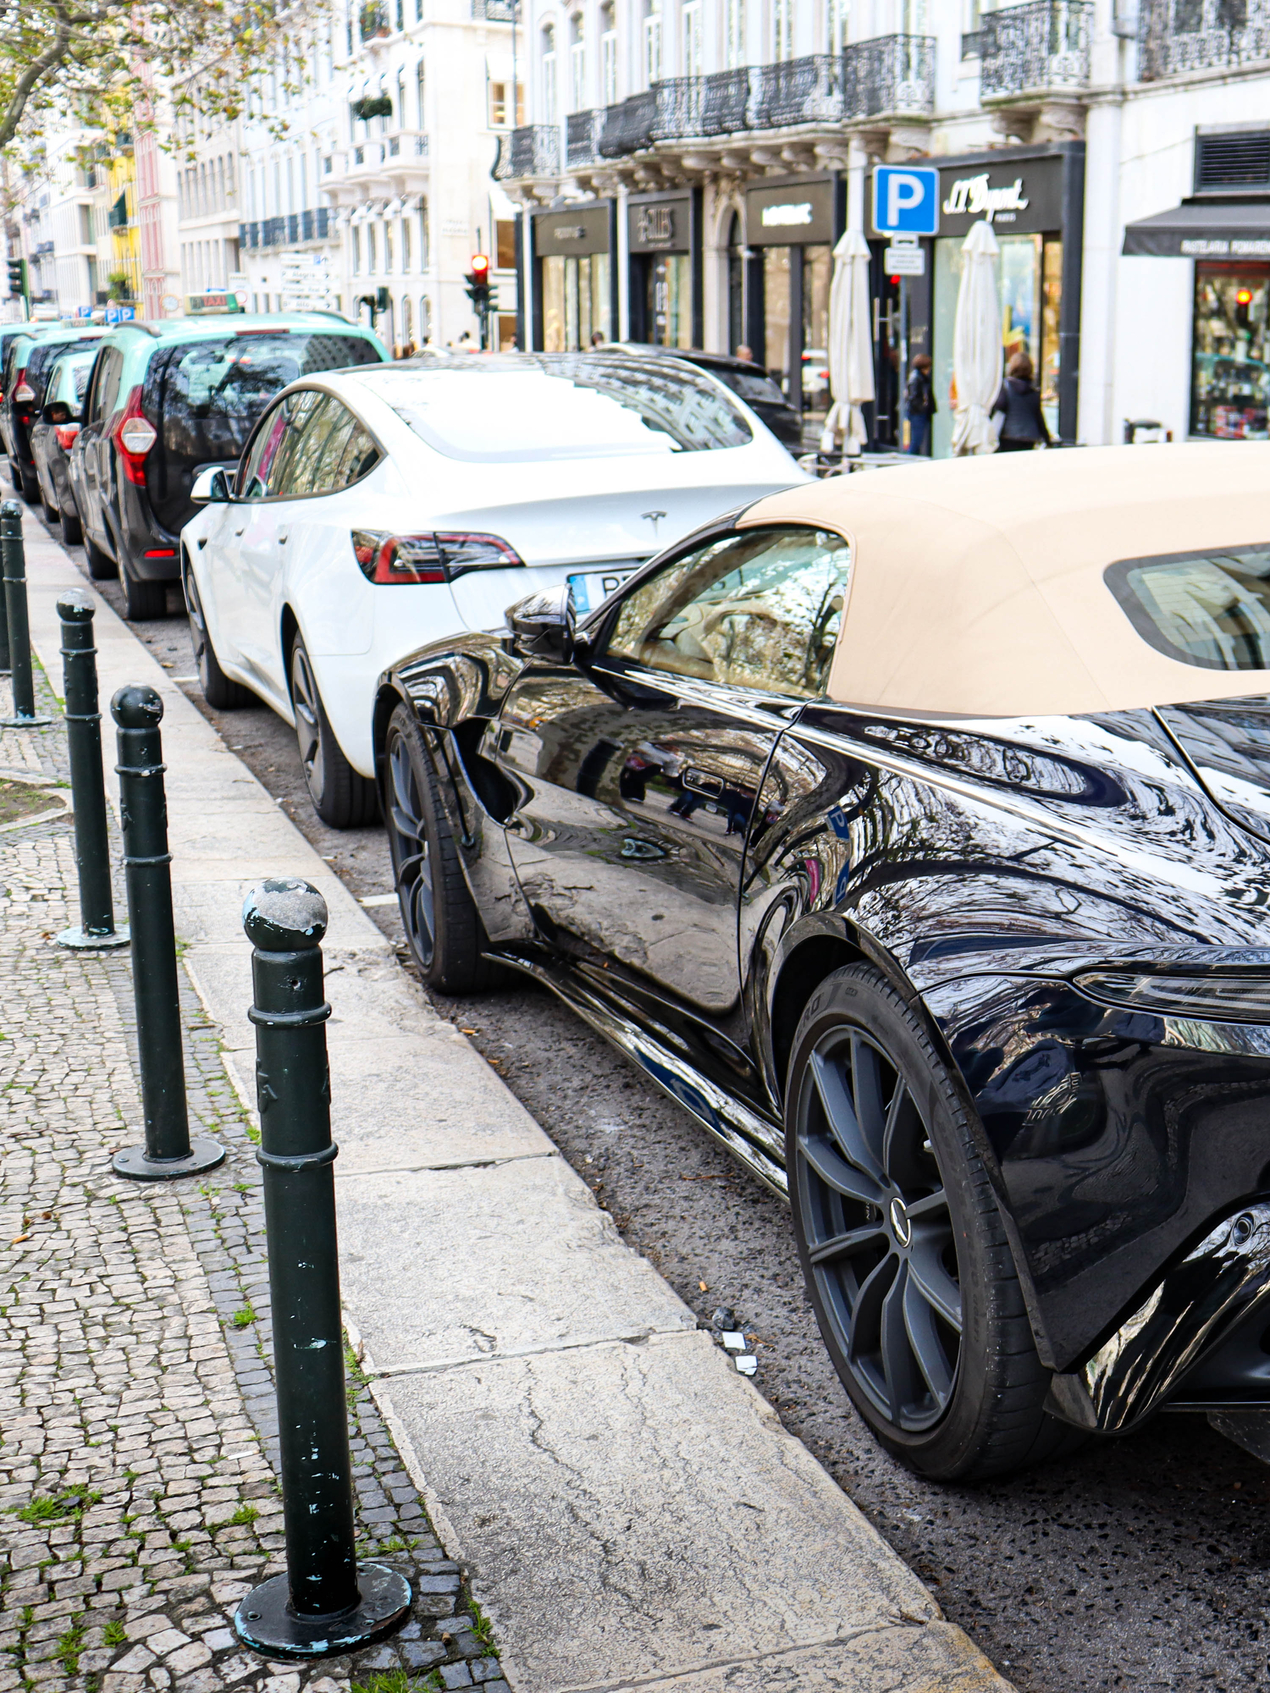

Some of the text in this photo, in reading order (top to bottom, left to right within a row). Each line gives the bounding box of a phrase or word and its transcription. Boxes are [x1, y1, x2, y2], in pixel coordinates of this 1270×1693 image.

[887, 174, 925, 227] P
[1181, 239, 1229, 254] PASTELARIA
[202, 295, 227, 307] TAXI
[81, 306, 89, 317] P
[107, 310, 117, 322] P
[122, 308, 131, 321] P
